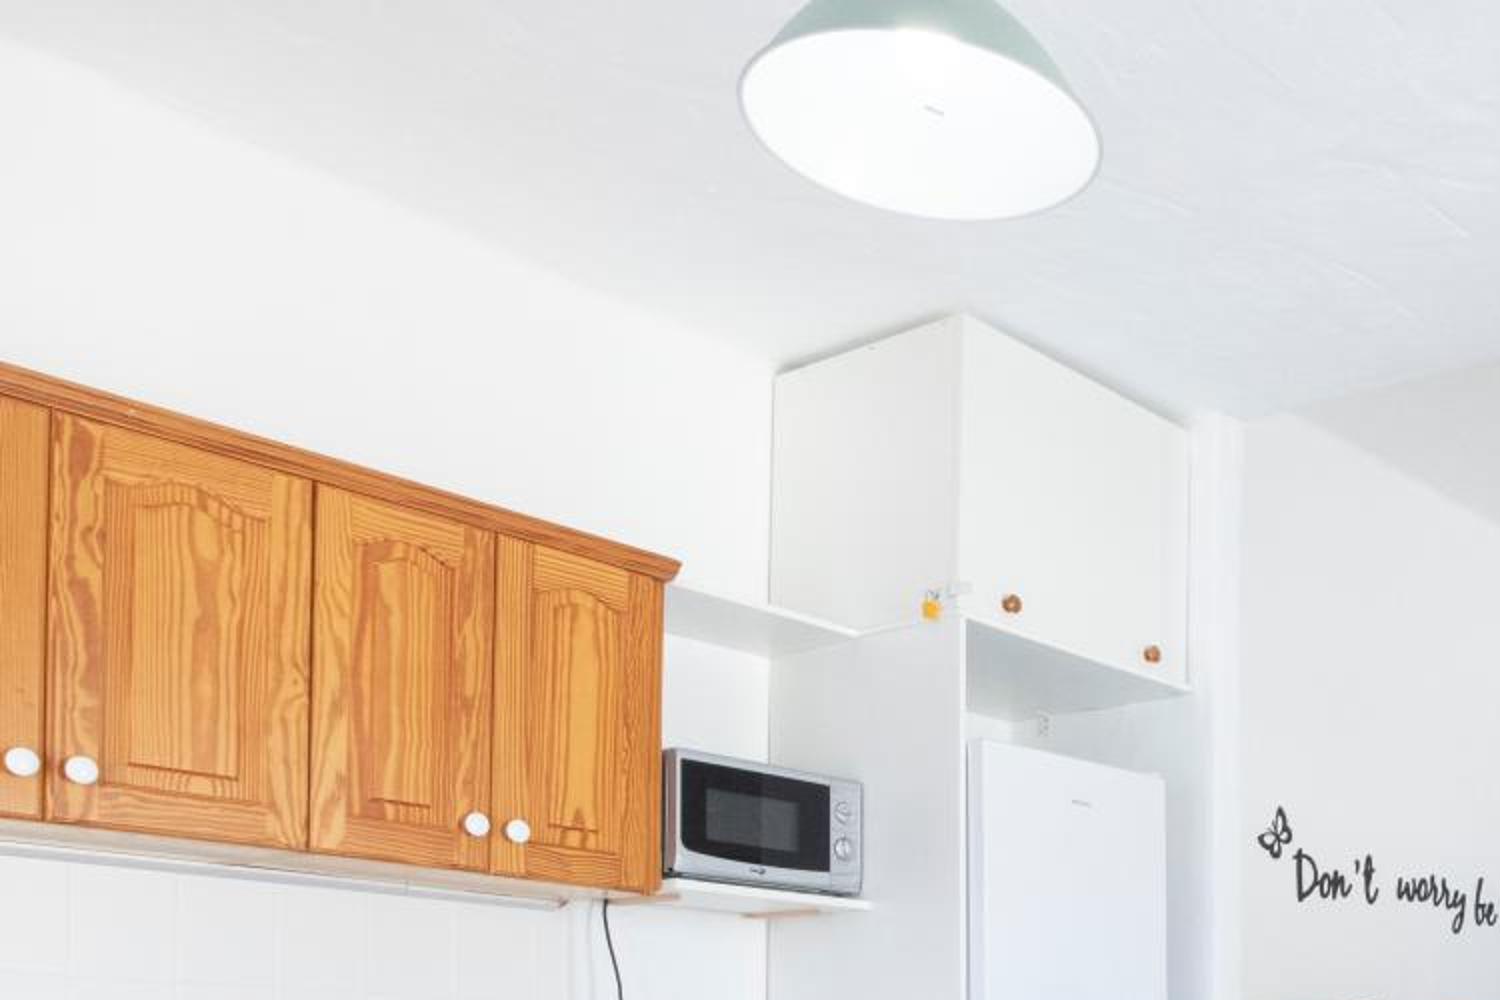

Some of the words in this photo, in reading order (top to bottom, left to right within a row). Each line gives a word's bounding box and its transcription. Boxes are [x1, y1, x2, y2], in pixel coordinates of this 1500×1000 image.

[1292, 847, 1380, 906] Don't
[1396, 874, 1467, 936] worry
[1474, 876, 1498, 928] be
